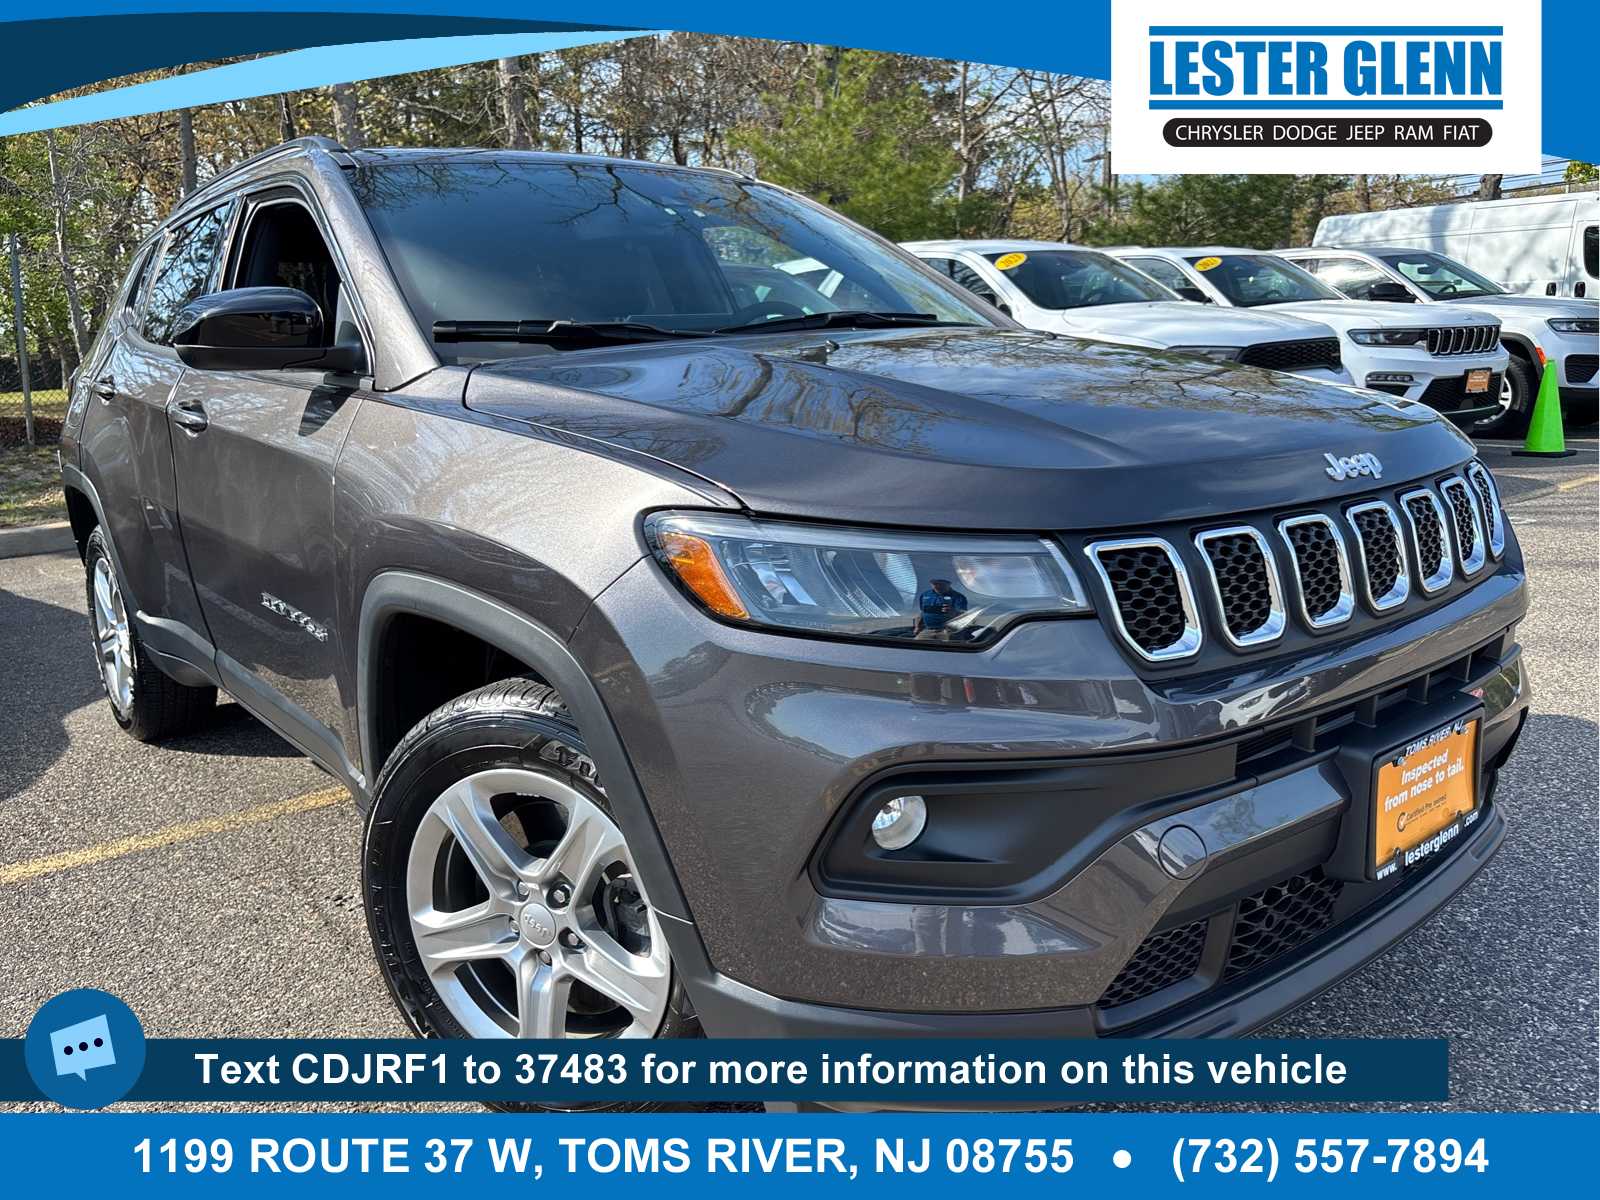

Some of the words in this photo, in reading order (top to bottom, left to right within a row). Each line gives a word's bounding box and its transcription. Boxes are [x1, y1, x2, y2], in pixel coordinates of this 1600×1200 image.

[1323, 452, 1384, 481] Jeep
[1385, 790, 1408, 812] from
[1410, 777, 1433, 797] nose
[1435, 769, 1445, 784] to
[1447, 755, 1464, 778] tail.
[1401, 748, 1448, 785] Inspected
[1376, 862, 1398, 881] www.
[1404, 823, 1459, 867] lesterglenn
[1463, 811, 1479, 828] .com
